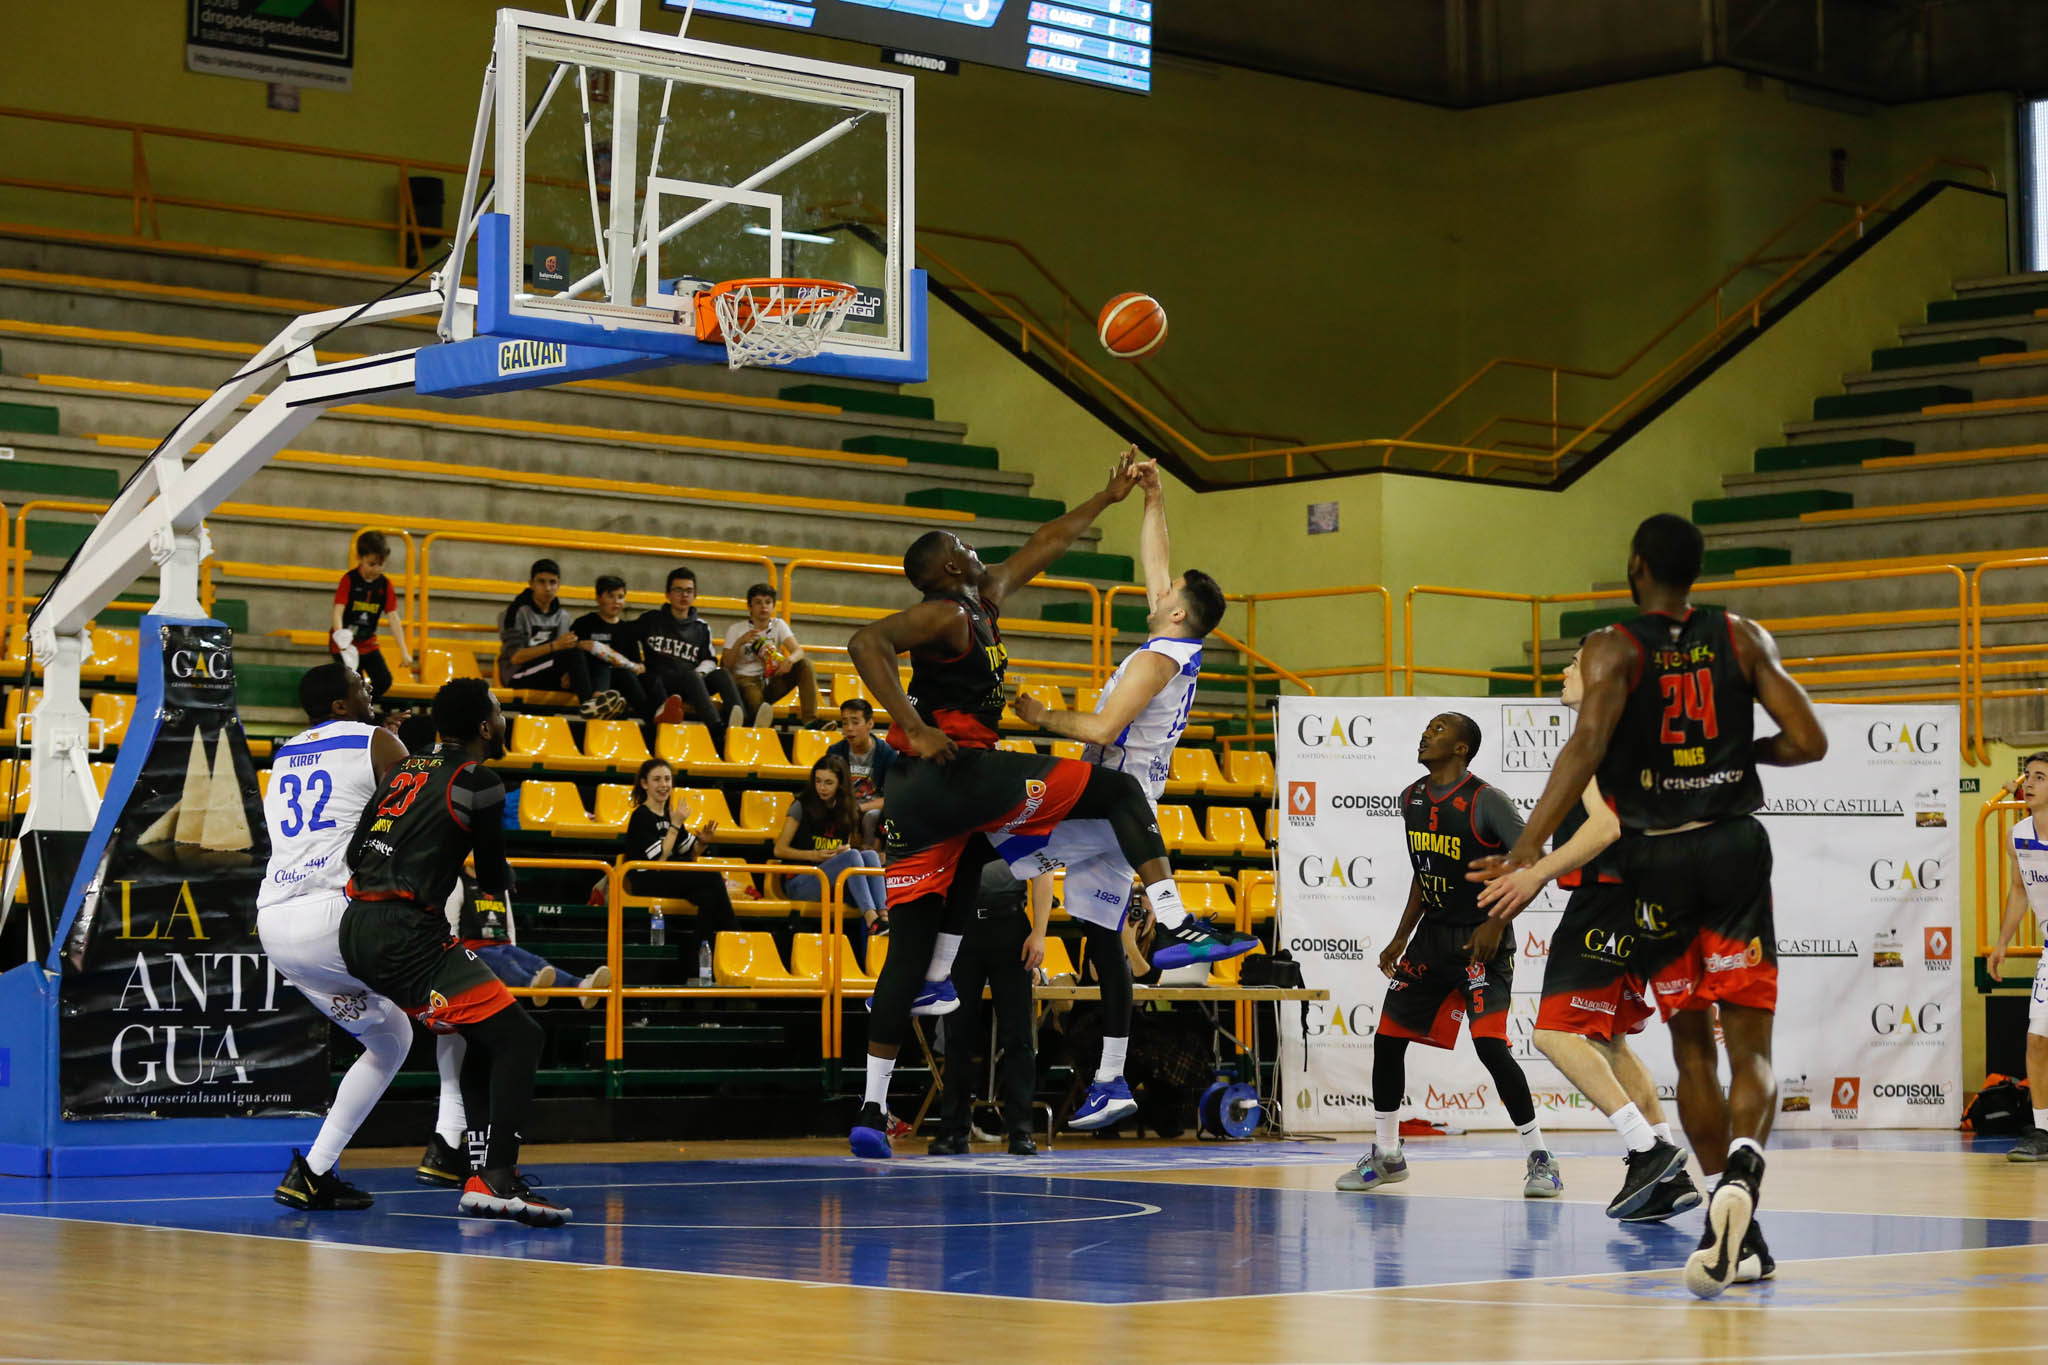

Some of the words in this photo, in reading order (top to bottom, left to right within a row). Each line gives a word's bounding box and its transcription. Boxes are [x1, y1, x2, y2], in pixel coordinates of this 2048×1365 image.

[201, 9, 339, 42] drogodependencias
[903, 53, 947, 71] MONDO
[1047, 55, 1078, 72] ALEX
[501, 341, 563, 370] GALVAN
[171, 650, 232, 680] GAG
[1506, 709, 1535, 727] LA
[1659, 667, 1719, 744] 24
[1298, 714, 1376, 748] GAG
[1506, 730, 1566, 747] ANTI-
[1868, 720, 1940, 753] GAG
[289, 753, 322, 768] KIRBY
[1673, 747, 1705, 766] JONES
[280, 770, 336, 837] 32
[377, 771, 430, 817] 23
[1823, 799, 1904, 812] CASTILLA
[1429, 806, 1439, 831] 5
[1408, 830, 1461, 860] TORMES
[1299, 855, 1376, 888] GAG
[1870, 858, 1945, 890] GAG
[113, 880, 210, 940] LA
[538, 905, 555, 914] FILA
[556, 906, 562, 914] 2
[1094, 889, 1120, 905] 1929
[1290, 938, 1363, 952] CODISOIL
[1585, 928, 1635, 958] GAG
[1777, 939, 1858, 953] CASTILLA
[112, 952, 298, 1012] ANTI-
[1474, 989, 1484, 1013] 5
[1871, 1003, 1945, 1035] GAG
[111, 1024, 254, 1086] GUA
[104, 1090, 292, 1107] www.queserialaantigua.com
[1873, 1084, 1945, 1098] CODISOIL
